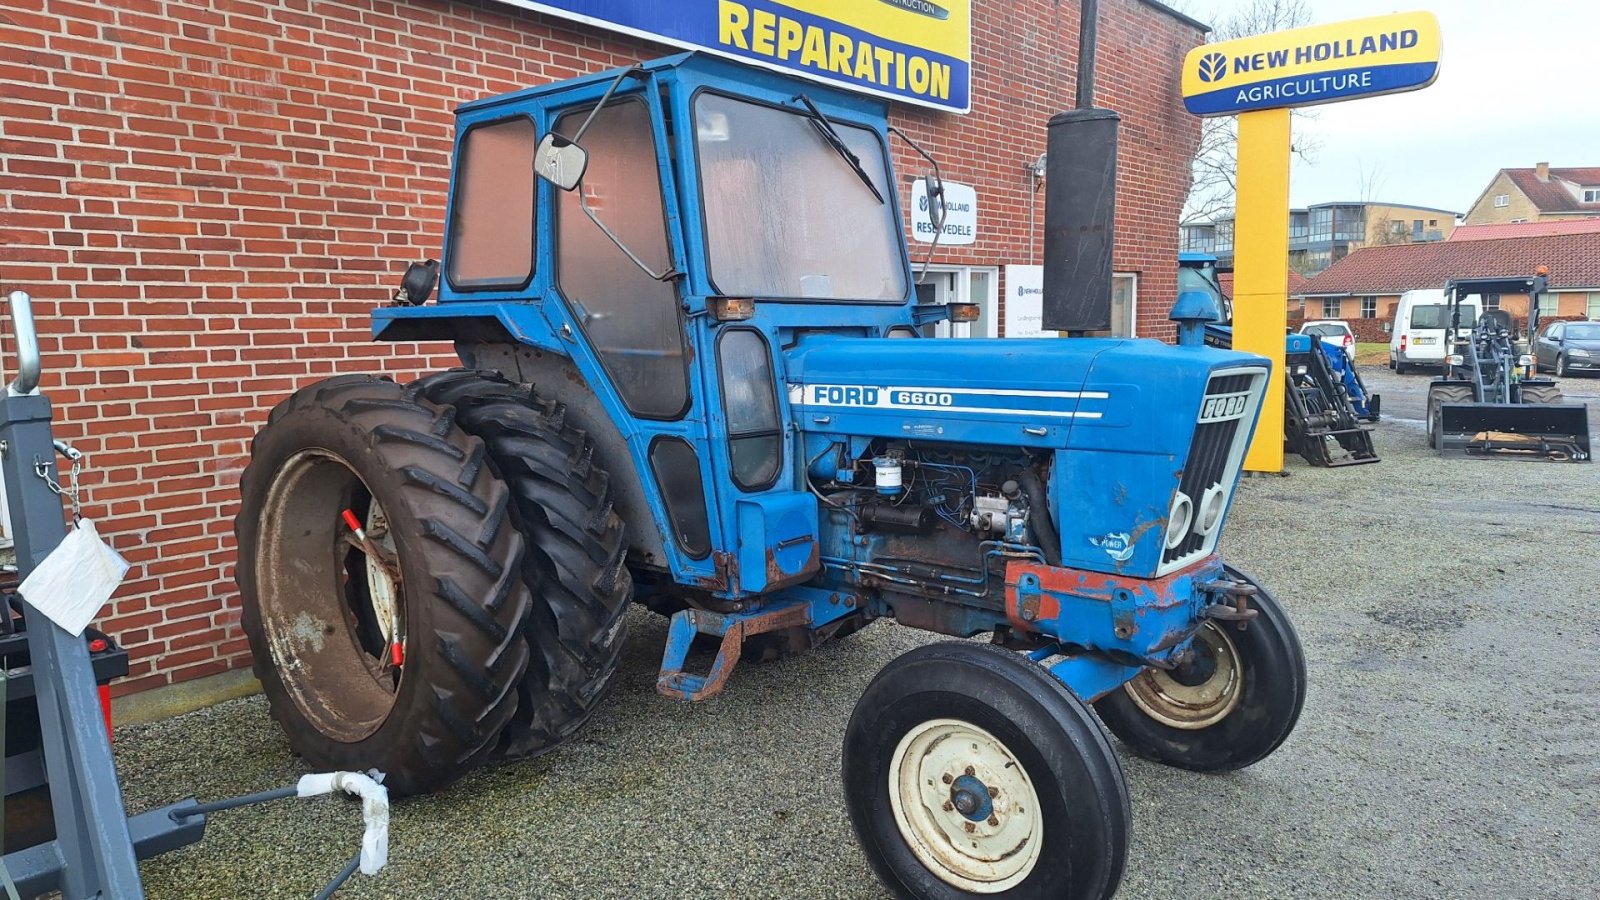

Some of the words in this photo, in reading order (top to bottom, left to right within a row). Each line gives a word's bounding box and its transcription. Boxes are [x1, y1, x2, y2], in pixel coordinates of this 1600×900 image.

[718, 0, 950, 100] REPARATION
[1233, 49, 1289, 74] NEW
[1295, 29, 1418, 65] HOLLAND
[1235, 71, 1372, 104] AGRICULTURE
[917, 222, 971, 236] RESVEDELE
[814, 386, 878, 406] FORD
[898, 391, 952, 406] 6600
[1203, 396, 1246, 418] FORD
